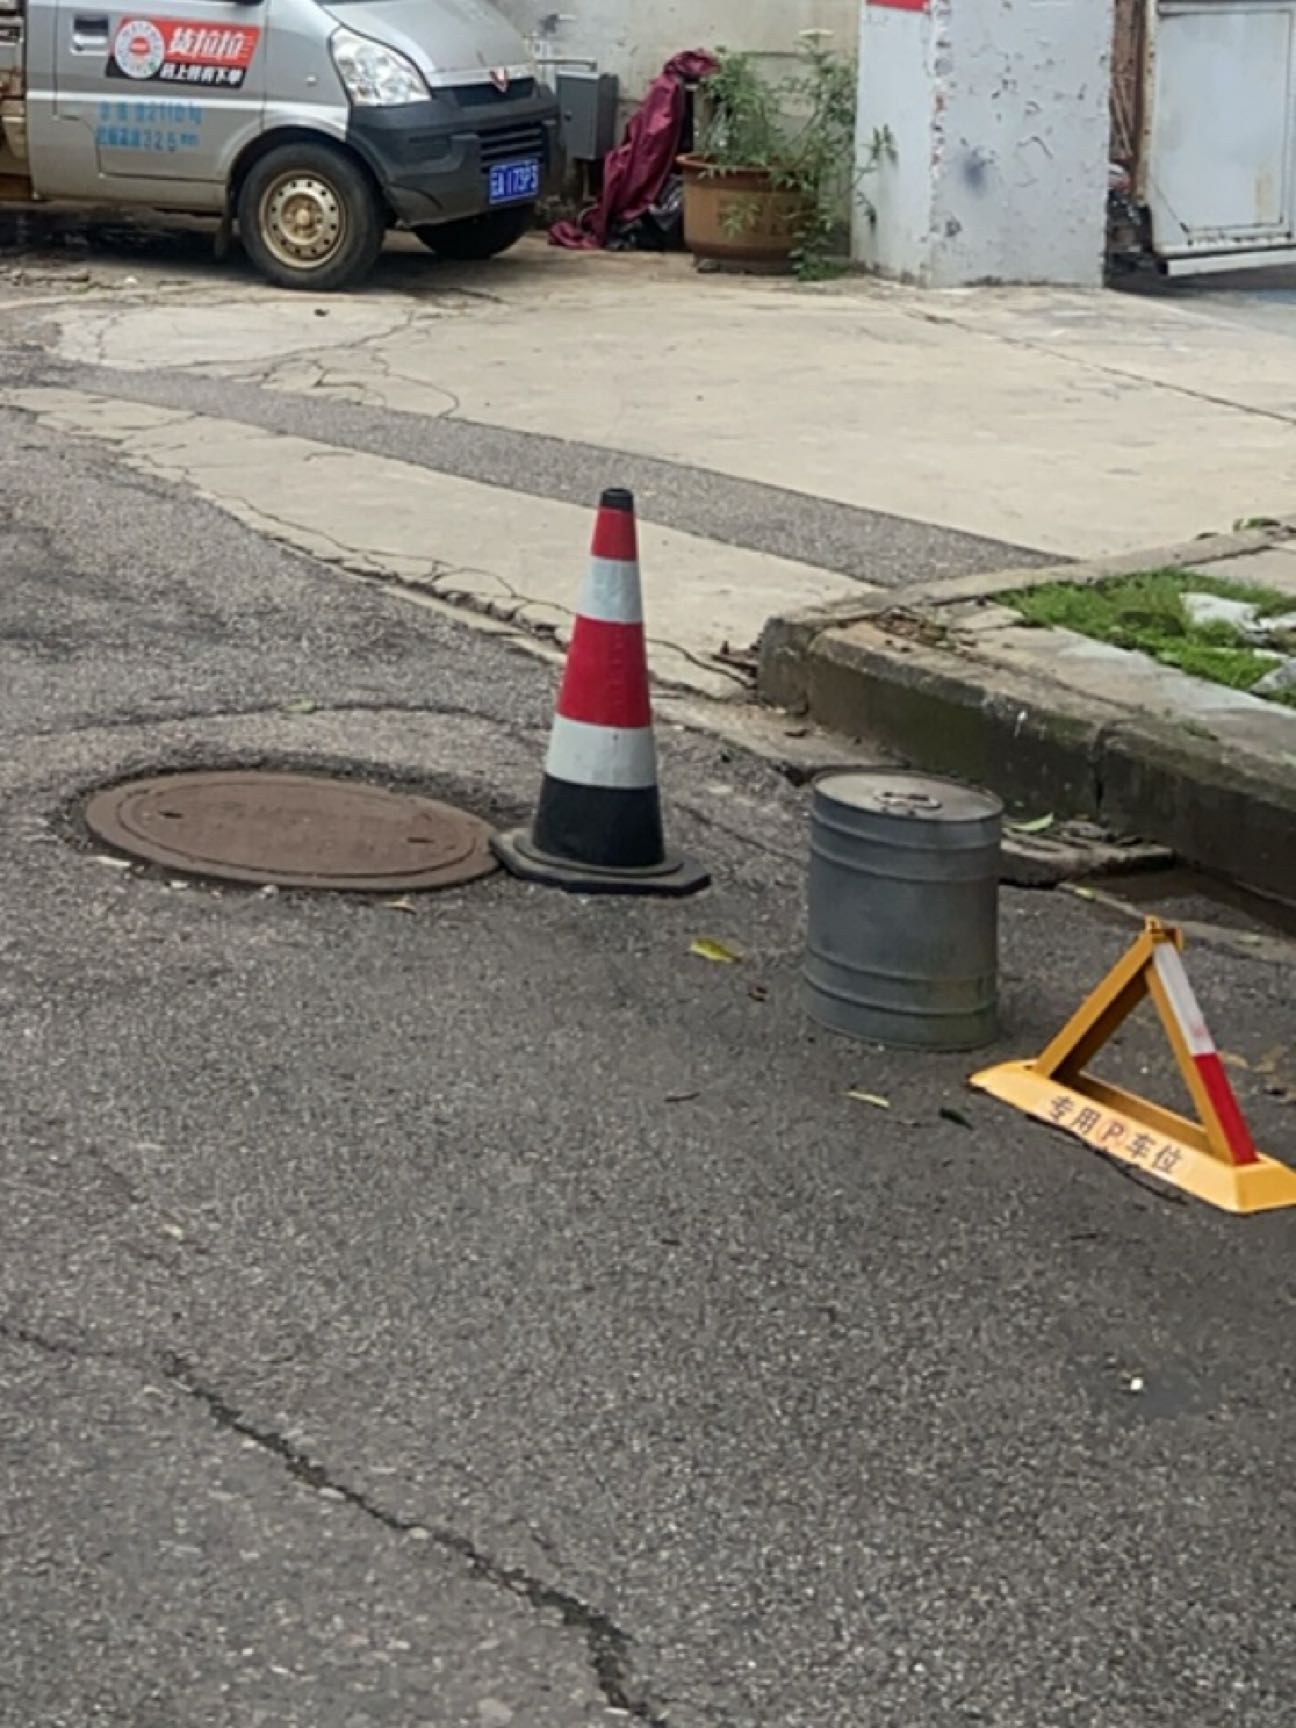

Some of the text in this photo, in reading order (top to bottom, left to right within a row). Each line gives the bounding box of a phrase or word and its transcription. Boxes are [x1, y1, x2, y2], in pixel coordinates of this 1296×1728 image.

[167, 26, 244, 60] 货拉拉
[1048, 1095, 1184, 1174] 专用P车位
